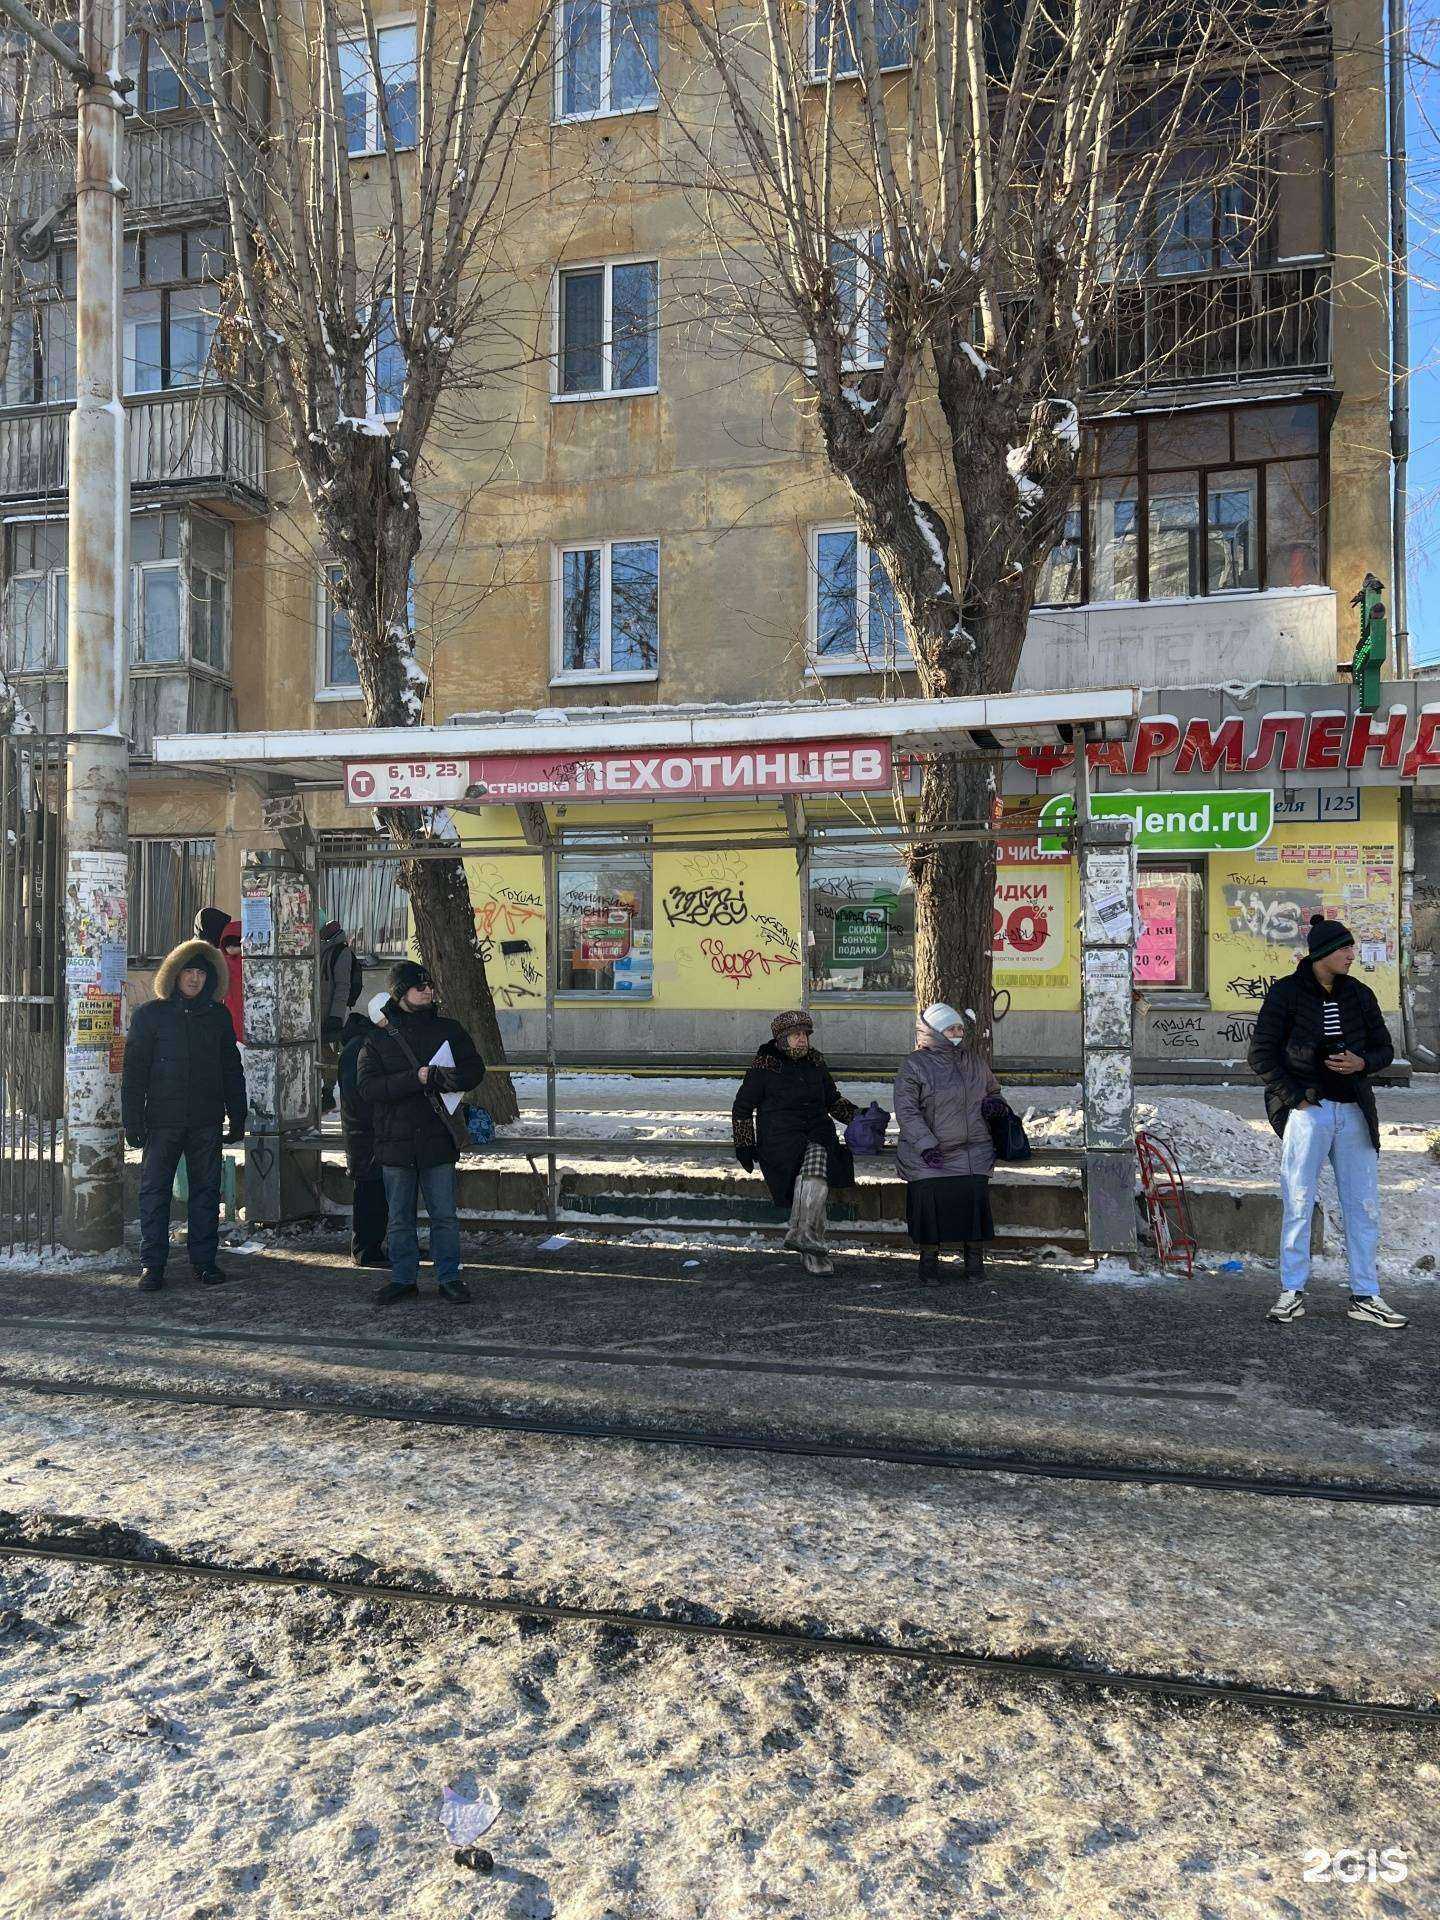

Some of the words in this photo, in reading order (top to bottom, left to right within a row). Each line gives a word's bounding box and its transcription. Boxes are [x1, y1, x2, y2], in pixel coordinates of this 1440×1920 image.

[408, 764, 431, 780] 19,
[435, 763, 462, 778] 23,
[576, 750, 882, 792] ПЕХОТИНЦЕВ
[388, 786, 412, 800] 24
[1323, 791, 1355, 812] 125
[1055, 804, 1257, 834] flend.ru
[994, 884, 1048, 901] ИДКИ
[848, 924, 882, 935] СКИДКИ
[842, 935, 877, 945] БОНУСЫ
[838, 946, 877, 956] ПОДАРКИ
[1135, 954, 1149, 967] 20
